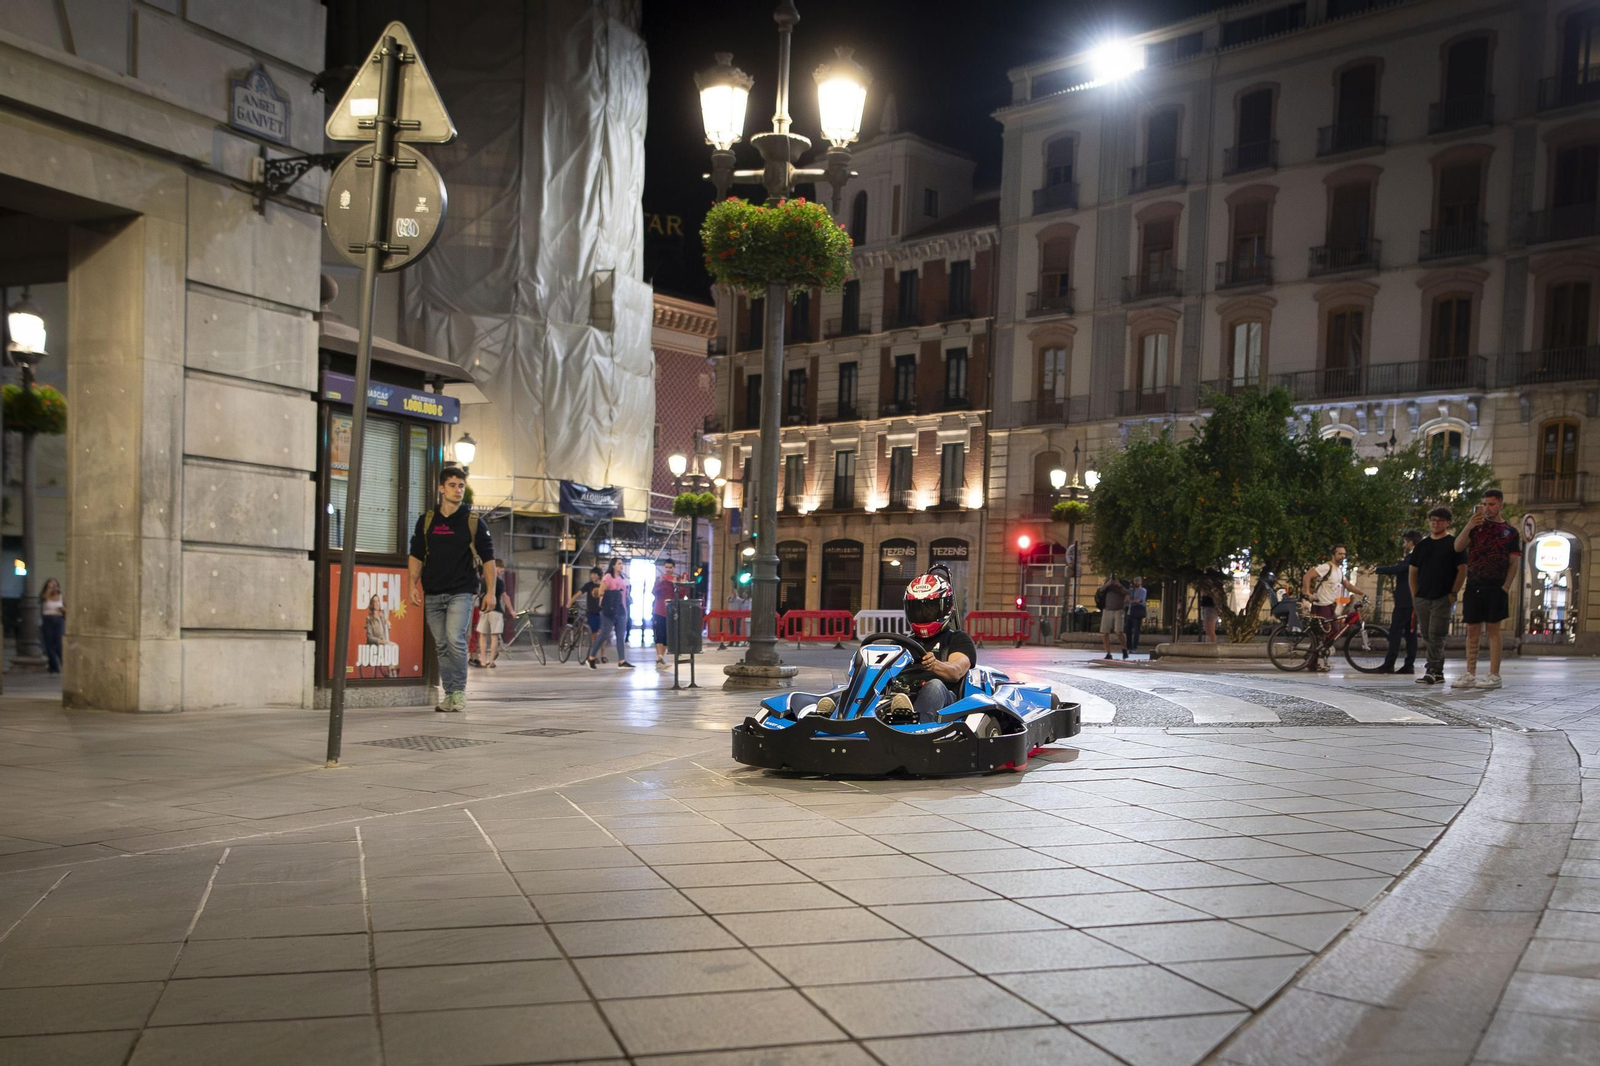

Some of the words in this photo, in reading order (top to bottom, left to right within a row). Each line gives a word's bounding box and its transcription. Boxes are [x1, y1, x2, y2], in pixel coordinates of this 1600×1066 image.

[237, 105, 284, 134] GANIVET
[883, 546, 916, 556] TEZENIS
[932, 546, 967, 556] TEZENIS
[356, 572, 401, 611] BIEN
[356, 644, 399, 667] JUGADO
[875, 653, 890, 664] 1
